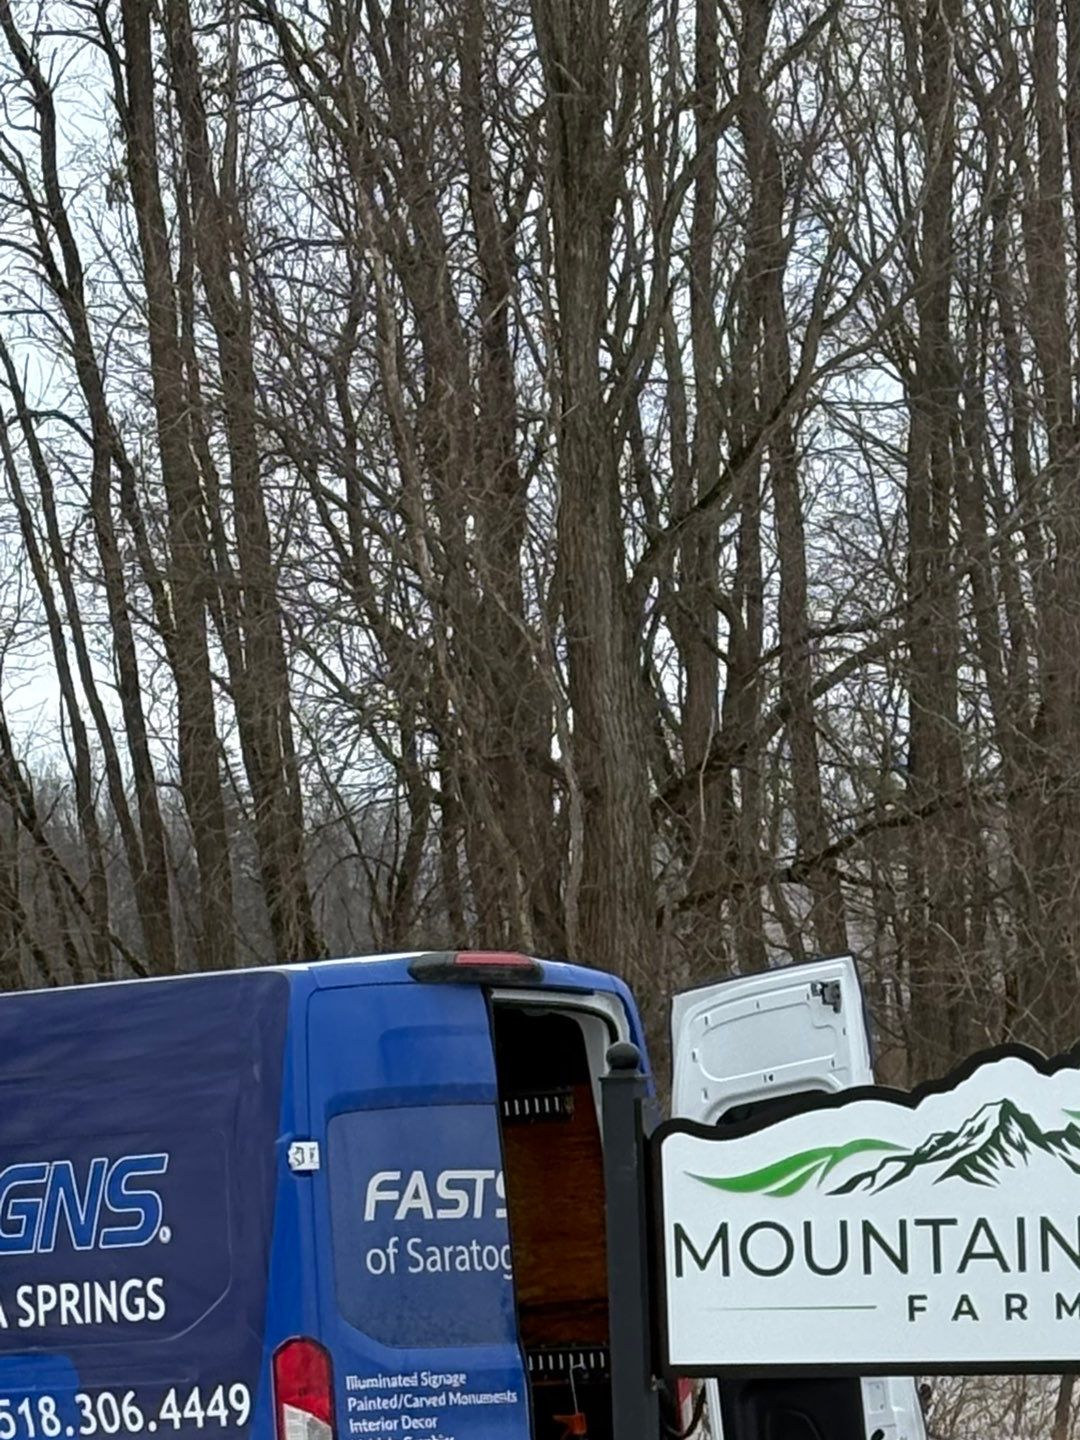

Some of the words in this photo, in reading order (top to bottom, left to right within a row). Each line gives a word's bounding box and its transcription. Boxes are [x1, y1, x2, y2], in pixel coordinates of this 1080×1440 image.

[366, 1236, 400, 1275] of
[16, 1277, 166, 1327] SPRINGS
[346, 1372, 418, 1390] Illuminated
[420, 1371, 467, 1388] Signage
[0, 1383, 250, 1440] 518.306.4449
[347, 1393, 446, 1412] Painted/Carved
[448, 1389, 518, 1406] Monuments
[349, 1417, 400, 1434] Interior
[401, 1415, 438, 1430] Decor
